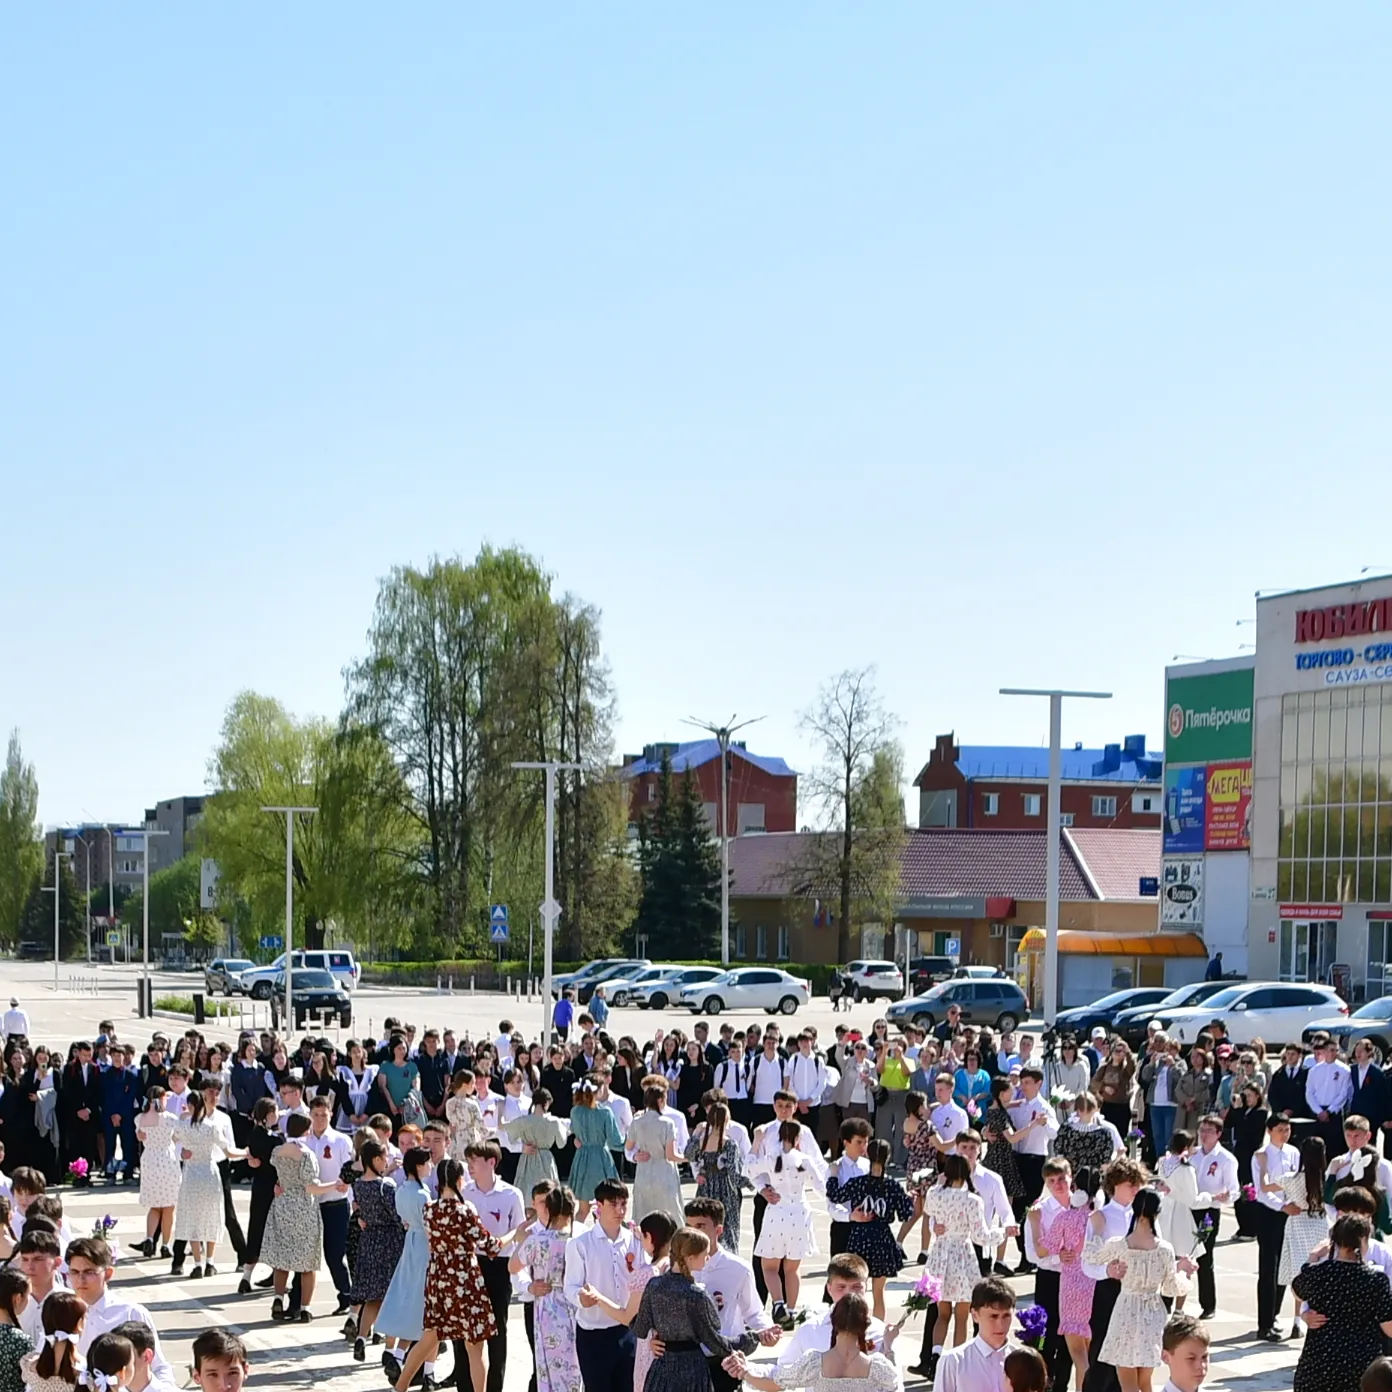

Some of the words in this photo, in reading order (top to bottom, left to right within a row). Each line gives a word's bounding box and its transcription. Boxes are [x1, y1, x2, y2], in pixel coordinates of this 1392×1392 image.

[1185, 706, 1251, 731] Пятёрочка
[1211, 775, 1240, 795] МЕГА
[1172, 888, 1194, 900] Bonus
